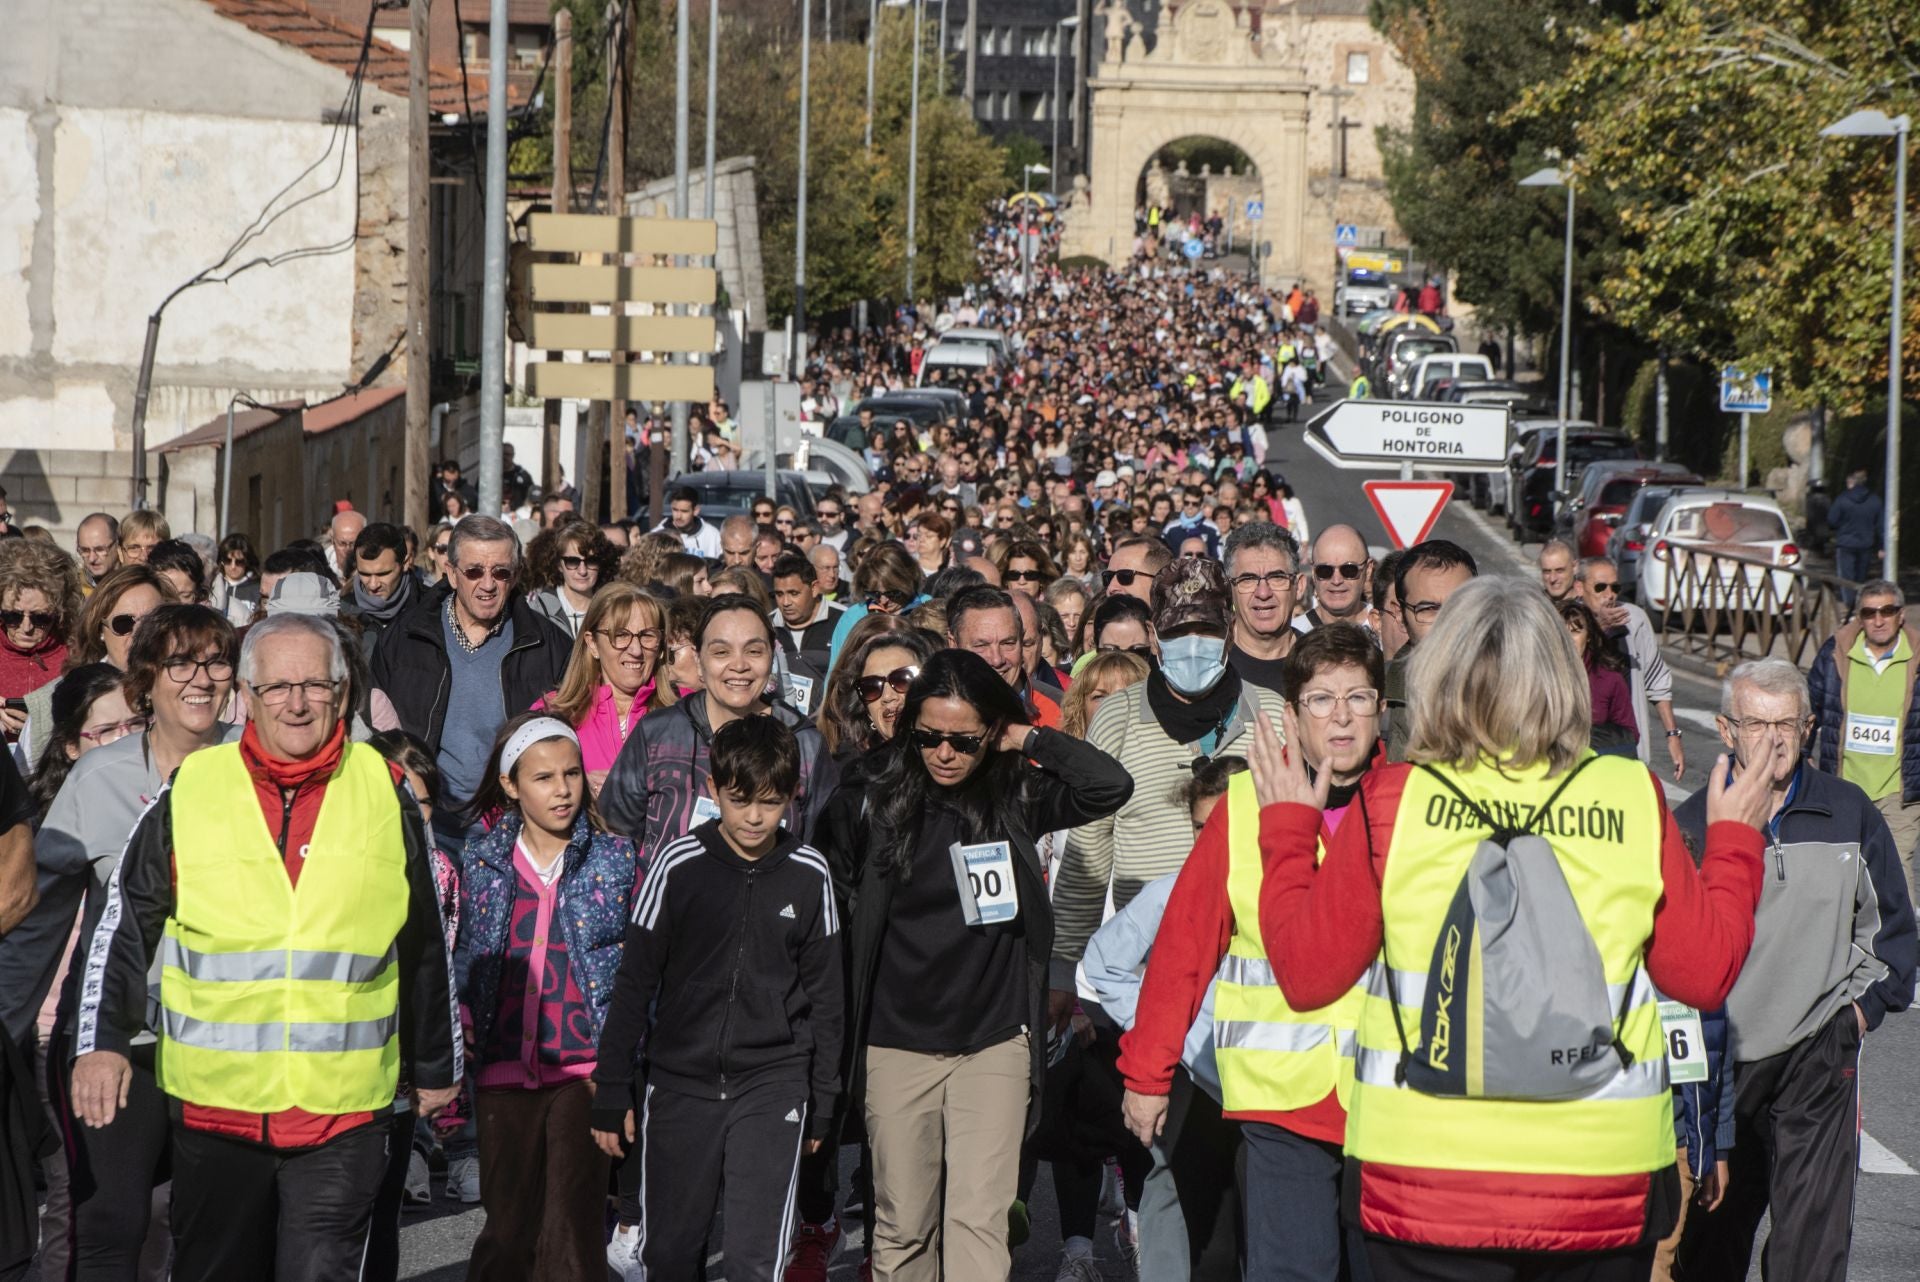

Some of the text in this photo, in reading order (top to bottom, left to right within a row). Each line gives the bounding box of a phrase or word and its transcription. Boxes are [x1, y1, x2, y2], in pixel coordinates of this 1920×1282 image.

[1382, 410, 1464, 425] POLIGONO
[1416, 427, 1431, 436] DE
[1382, 439, 1464, 454] HONTORIA
[1852, 726, 1891, 742] 6404
